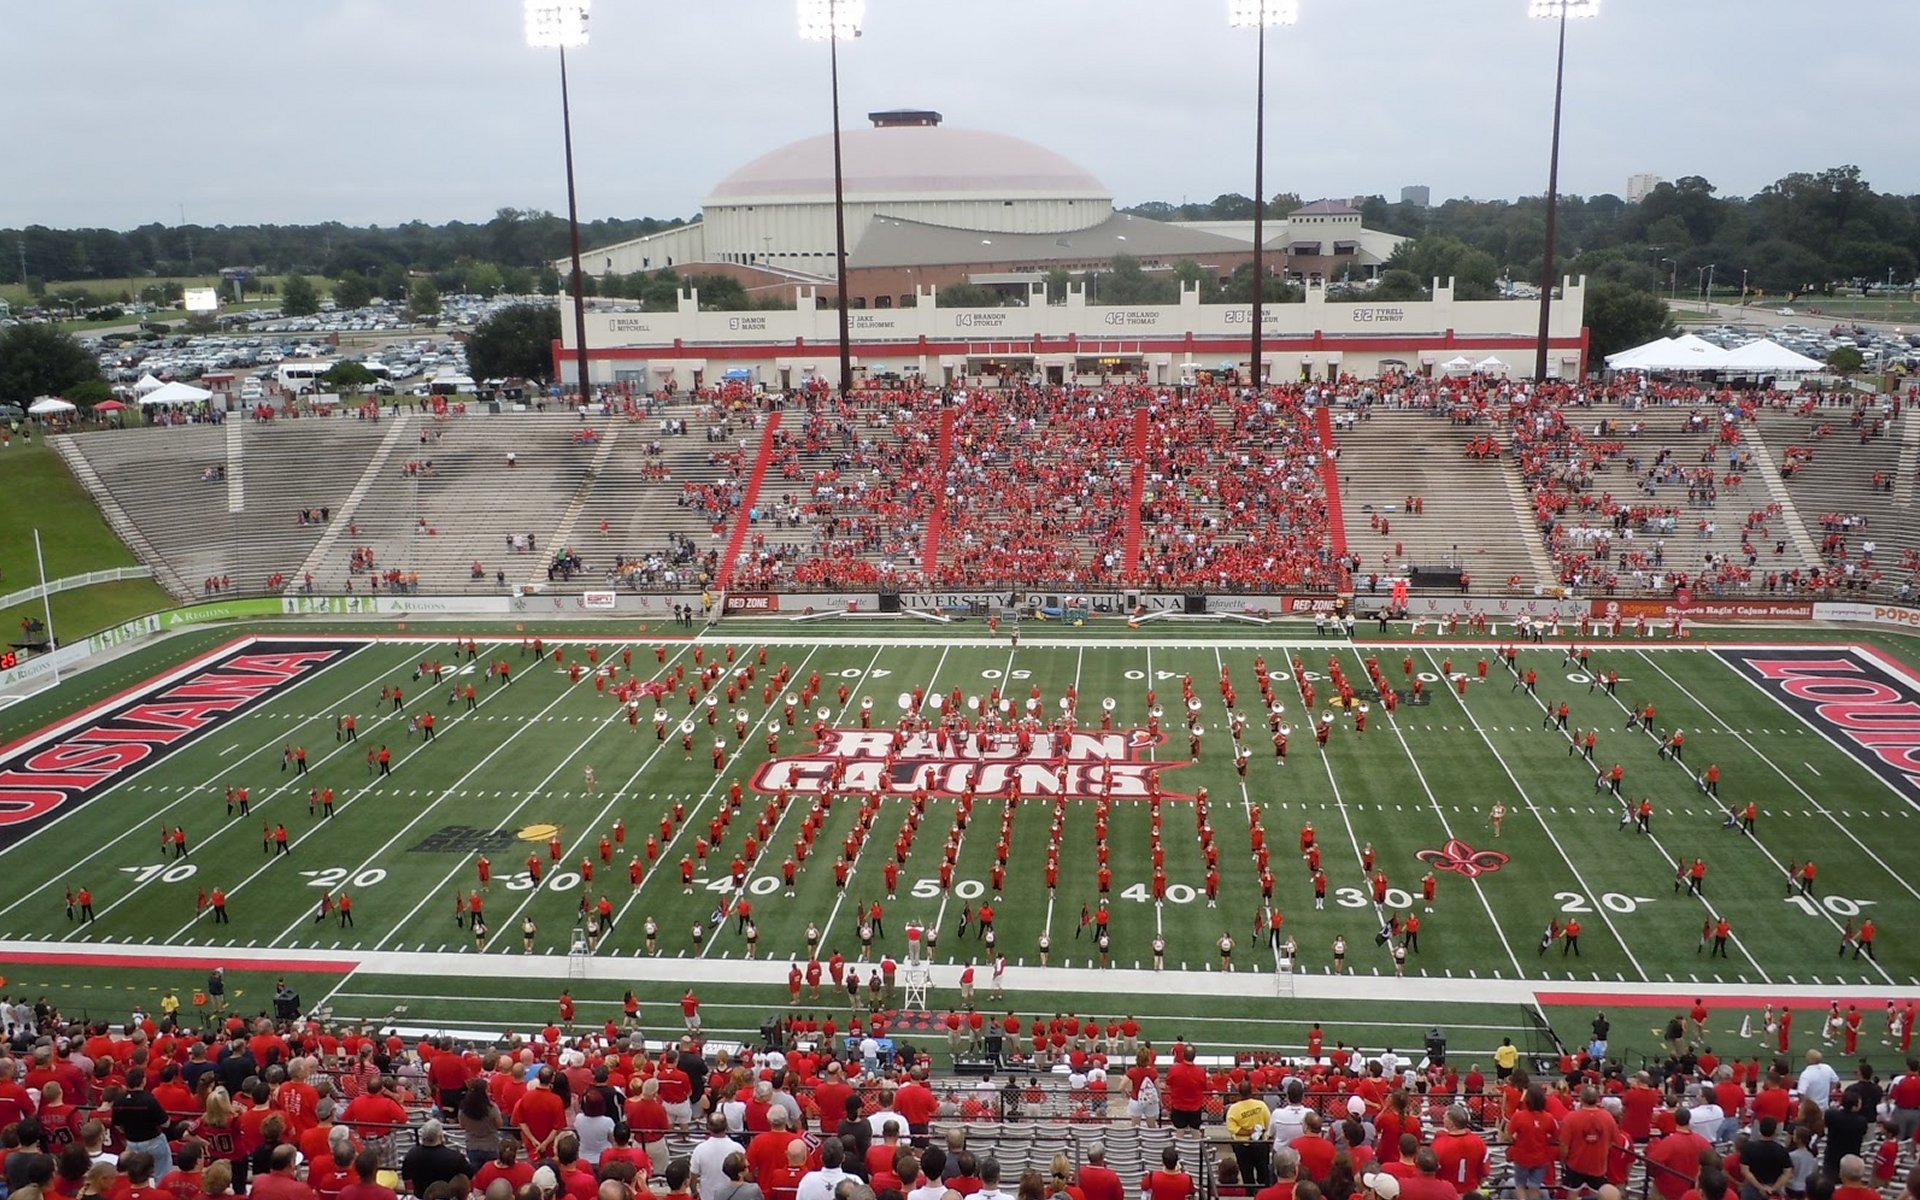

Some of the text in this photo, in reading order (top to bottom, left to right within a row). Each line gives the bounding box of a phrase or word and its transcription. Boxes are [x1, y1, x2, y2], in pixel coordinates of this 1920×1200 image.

[956, 313, 972, 327] 14
[1105, 312, 1125, 325] 42
[1225, 310, 1246, 324] 28
[1353, 309, 1374, 322] 32
[404, 601, 446, 611] REGIONS
[728, 597, 768, 609] RED ZONE
[1293, 599, 1335, 610] RED ZONE
[185, 608, 230, 621] REGIONS
[1706, 606, 1735, 615] Ragin'
[1737, 606, 1767, 616] Cajuns
[1769, 607, 1810, 616] Football!
[1, 652, 15, 669] 25
[841, 667, 892, 678] 40
[981, 668, 1033, 680] 50
[1124, 669, 1176, 681] 40
[760, 760, 1153, 797] CAJUNS
[134, 863, 198, 883] 10
[306, 867, 387, 887] 20
[506, 871, 580, 892] 30
[706, 875, 781, 896] 40
[910, 879, 985, 899] 50
[1120, 882, 1197, 904] 40
[1335, 887, 1414, 910] 30
[1553, 891, 1637, 914] 20
[1784, 895, 1860, 916] 10
